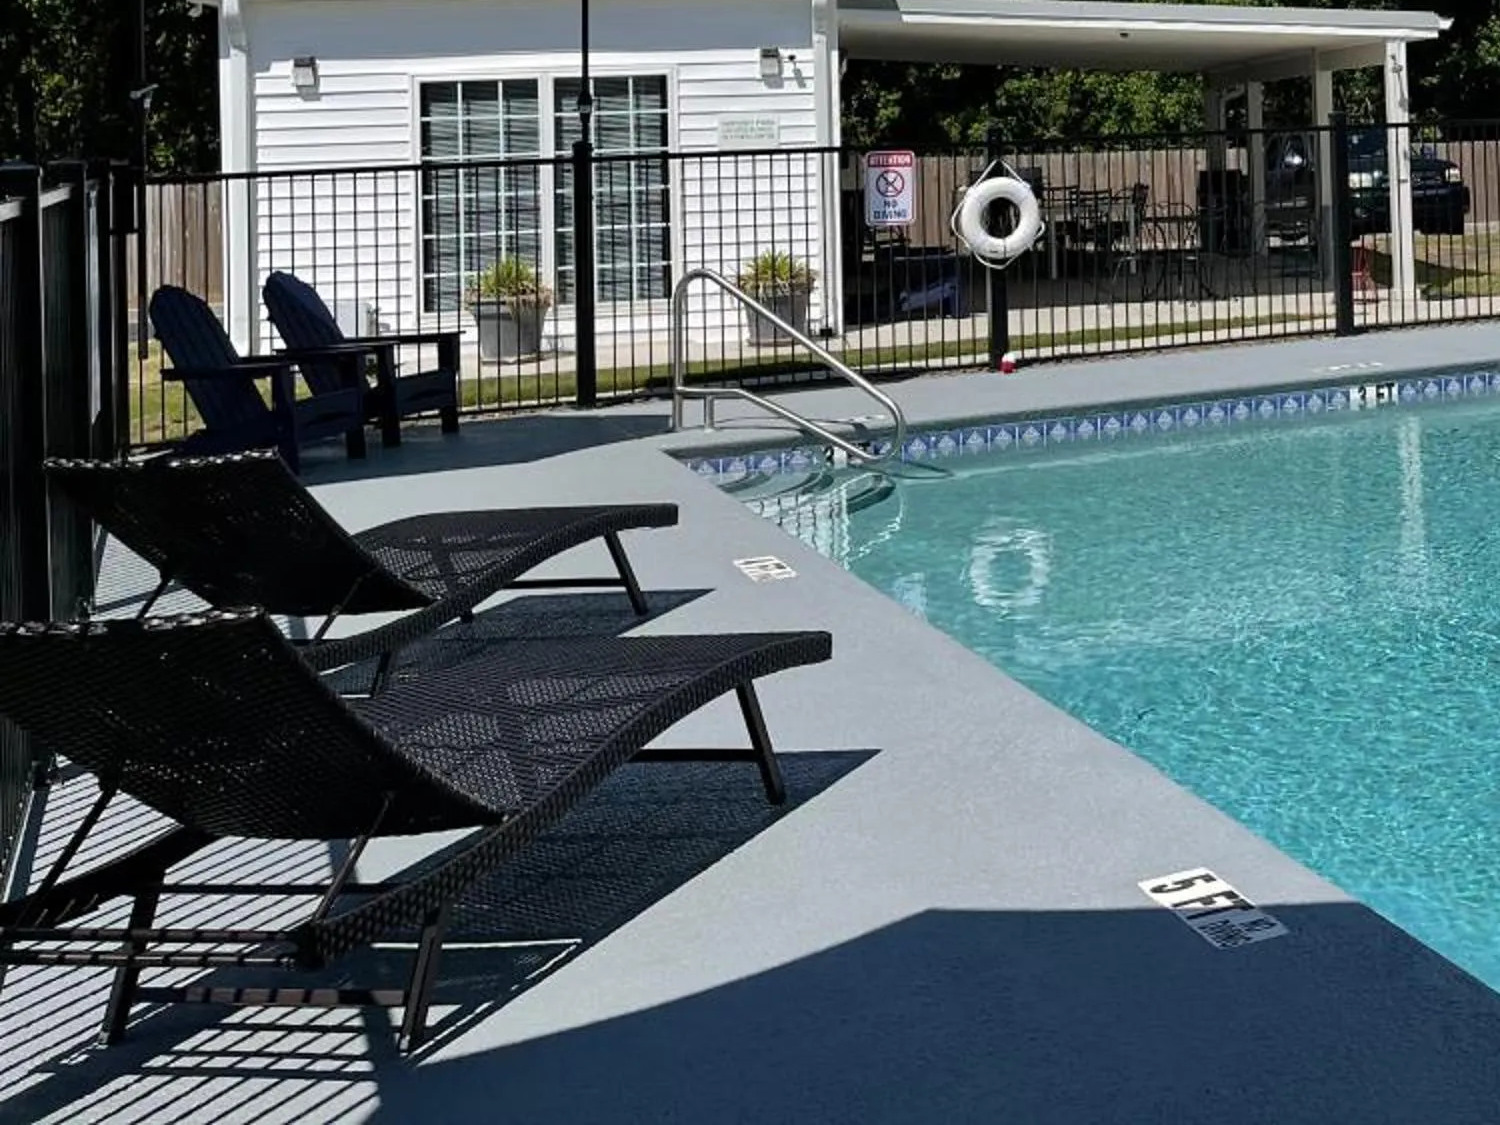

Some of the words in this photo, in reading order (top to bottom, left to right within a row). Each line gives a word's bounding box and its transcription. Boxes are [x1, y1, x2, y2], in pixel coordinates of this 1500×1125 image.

[883, 198, 898, 209] NO
[873, 208, 908, 221] DIVING
[1375, 382, 1395, 403] FT
[1150, 873, 1217, 894] 5
[1171, 890, 1256, 920] FT
